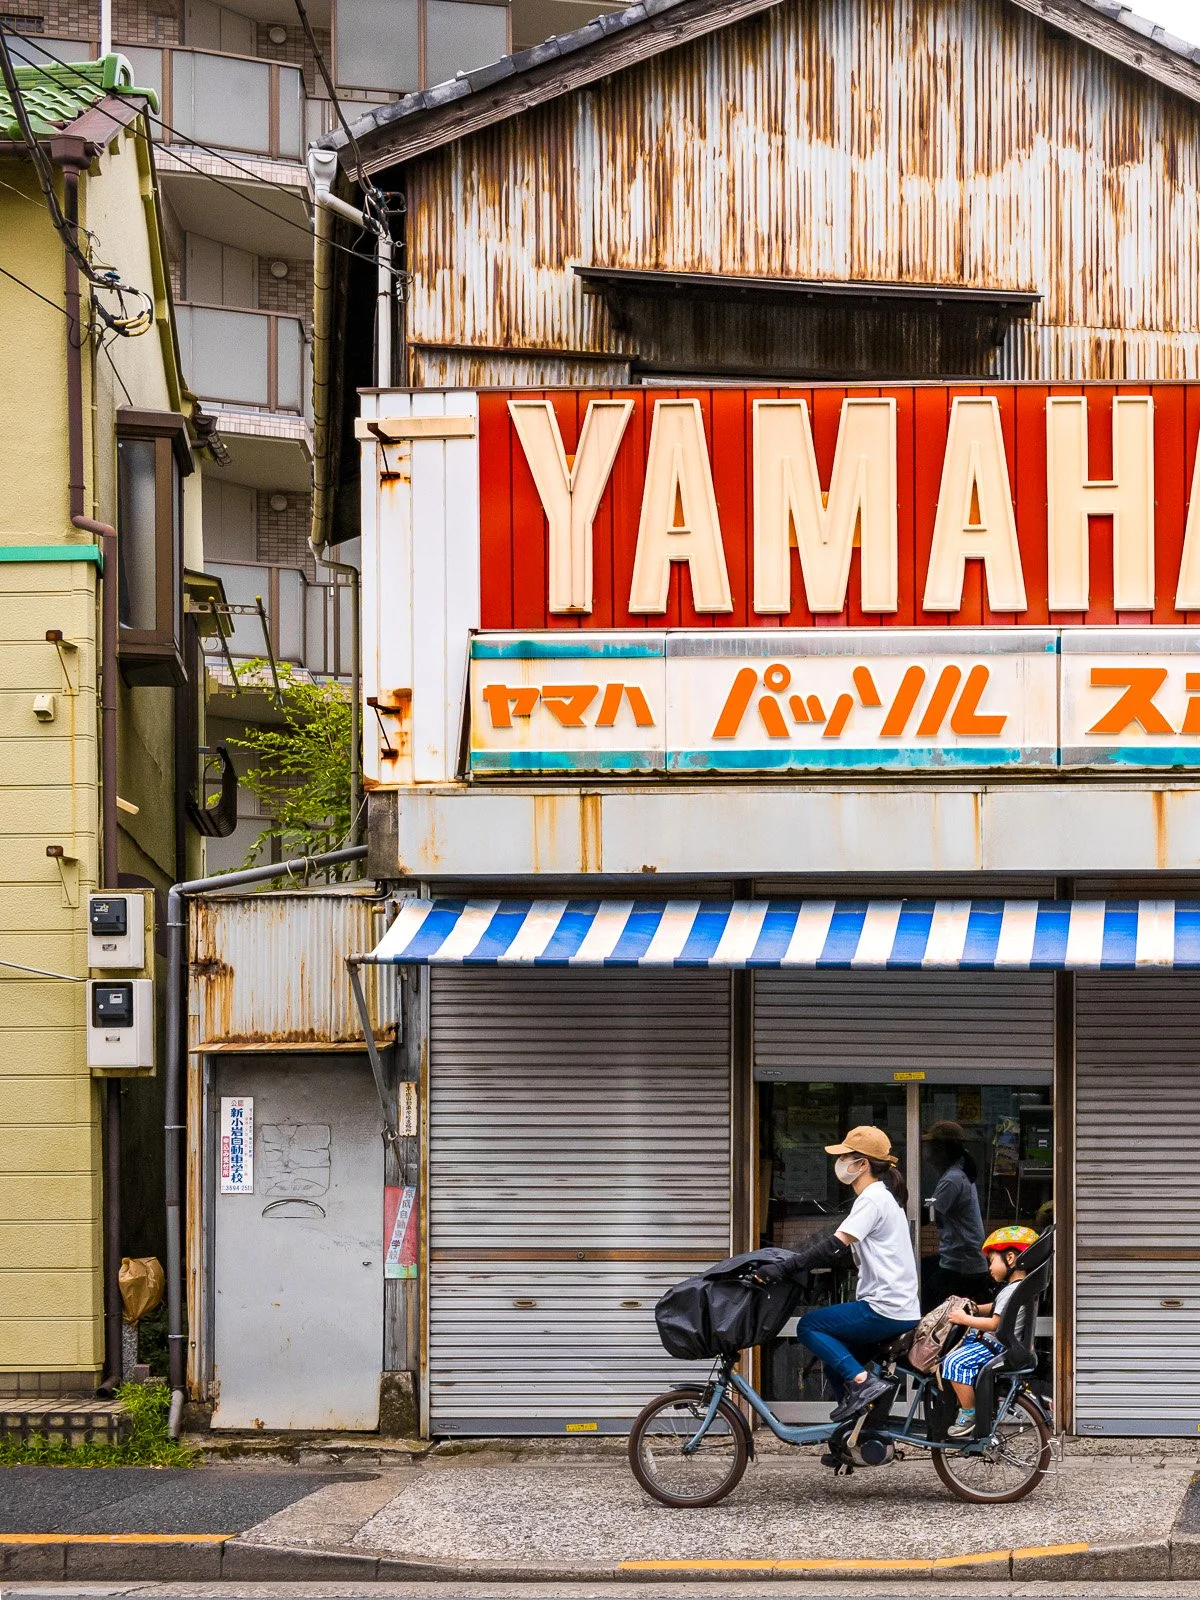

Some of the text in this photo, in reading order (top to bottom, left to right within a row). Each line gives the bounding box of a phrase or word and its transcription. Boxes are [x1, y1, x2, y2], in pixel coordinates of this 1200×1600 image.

[483, 684, 654, 727] ヤマハ
[712, 664, 1007, 738] パッソル
[231, 1108, 243, 1183] 新小岩自動車学校
